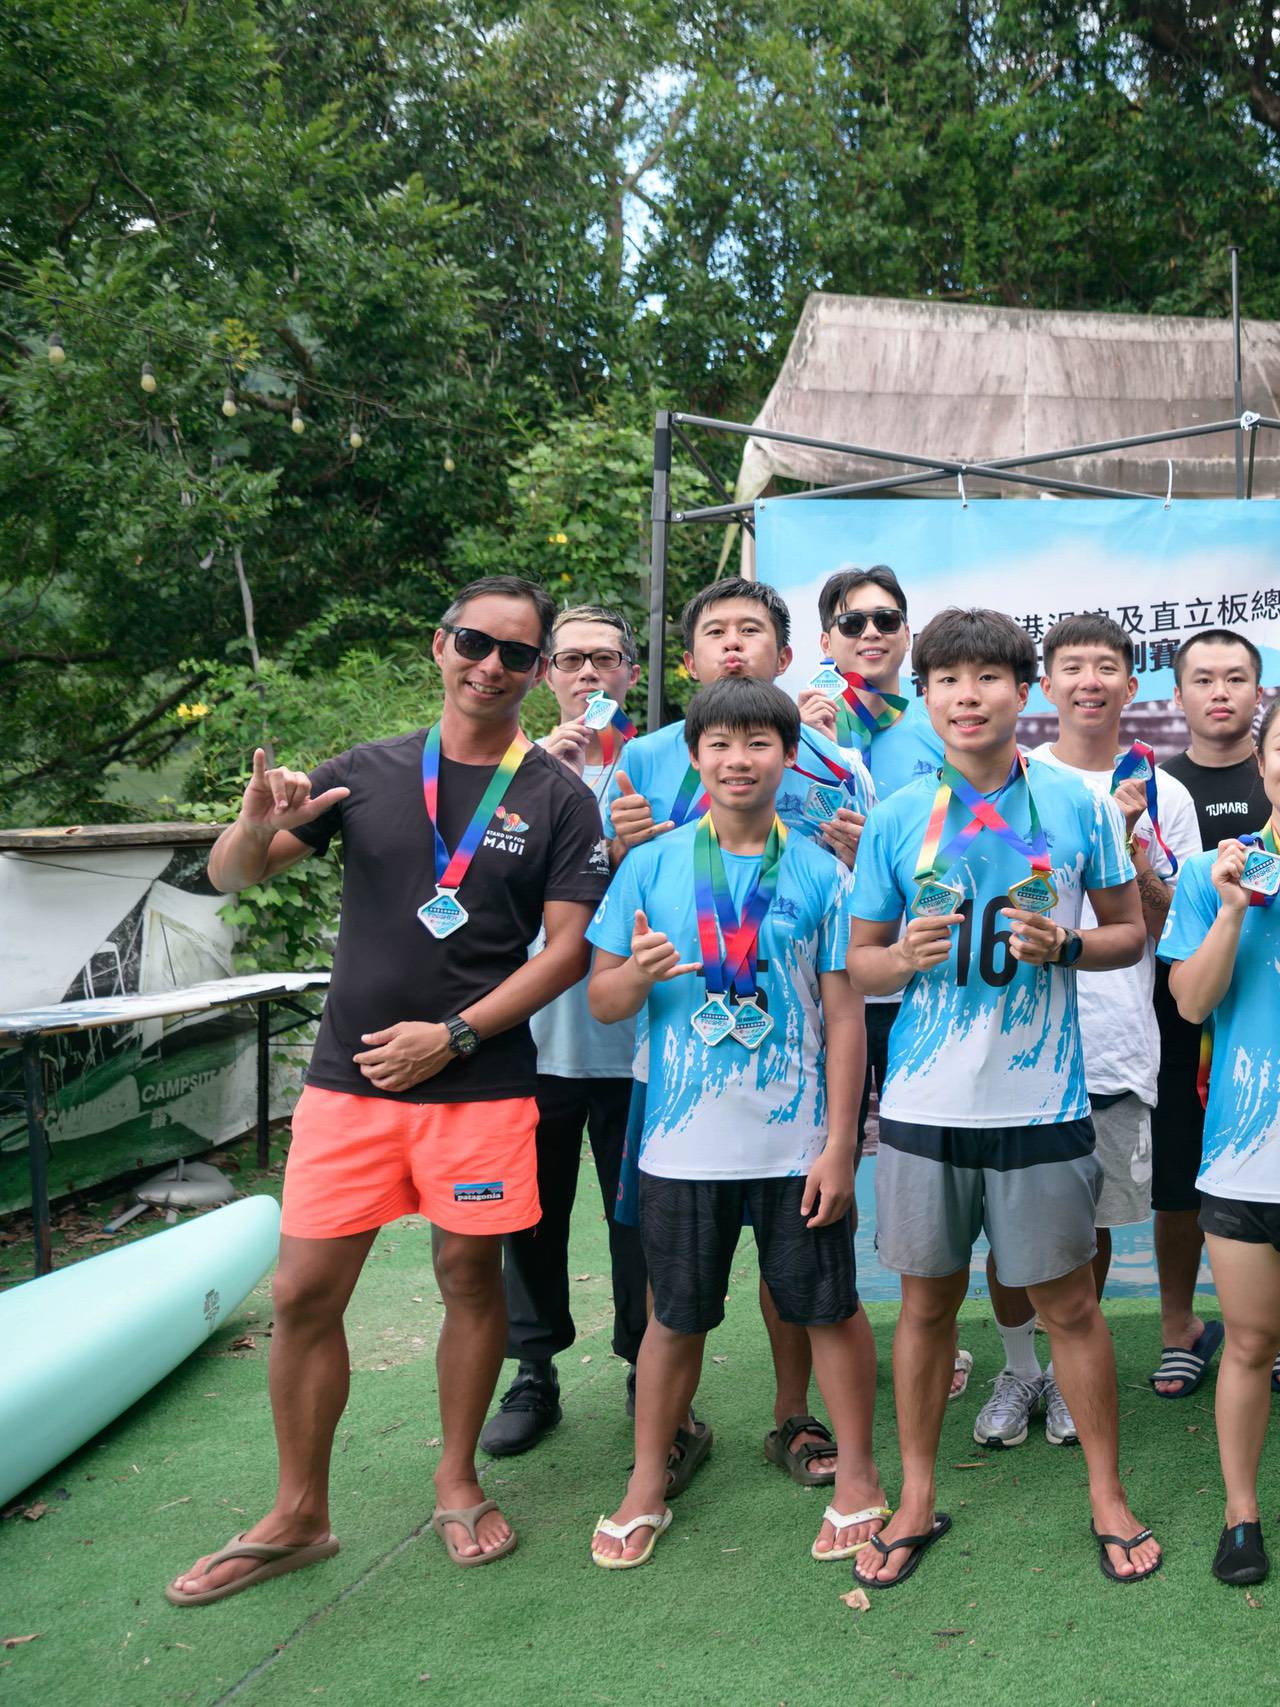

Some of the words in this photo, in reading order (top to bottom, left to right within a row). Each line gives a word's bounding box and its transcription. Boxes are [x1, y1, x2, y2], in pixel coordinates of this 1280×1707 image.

[486, 830, 505, 838] STAND
[513, 836, 526, 844] FOR
[483, 836, 525, 856] MAUI
[955, 895, 1018, 987] 16
[457, 1193, 502, 1201] patagonia
